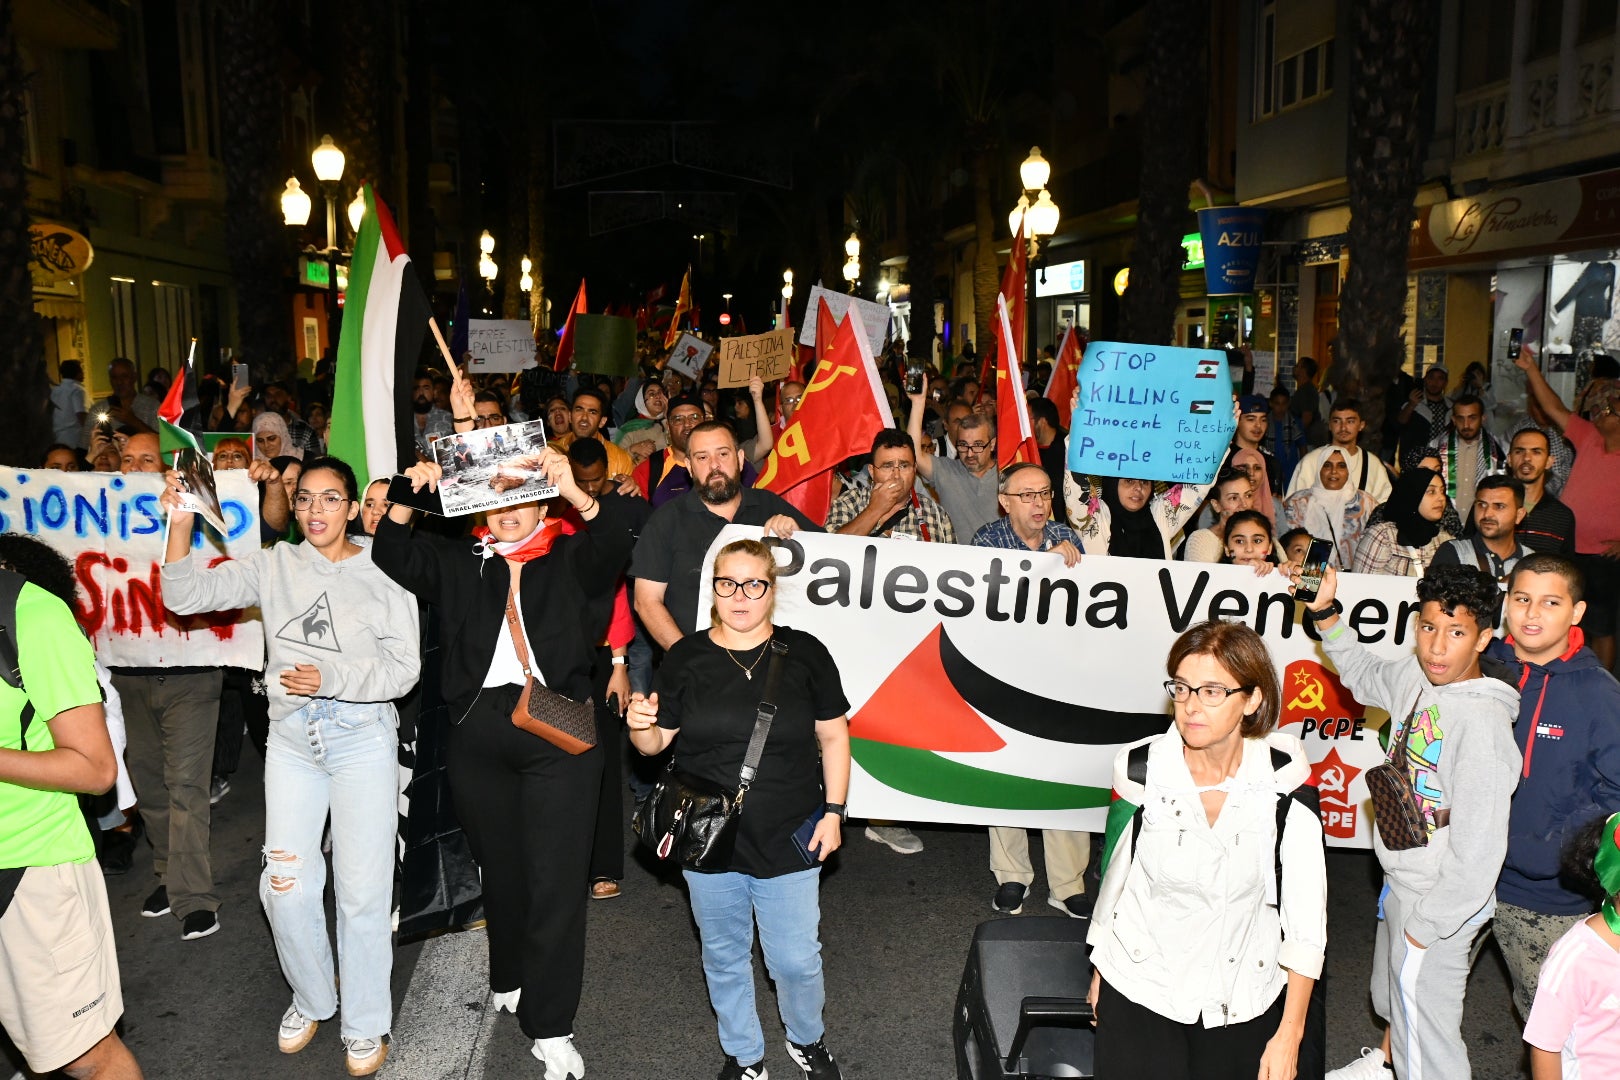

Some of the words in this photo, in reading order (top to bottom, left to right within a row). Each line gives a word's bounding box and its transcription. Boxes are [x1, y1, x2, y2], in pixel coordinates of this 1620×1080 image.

[1444, 203, 1480, 246] La
[1217, 231, 1260, 247] AZUL
[470, 328, 507, 340] #FREE
[724, 336, 784, 360] PALESTINA
[729, 354, 784, 382] LIBRE
[1094, 350, 1156, 372] STOP
[1090, 382, 1180, 405] KILLING
[1083, 409, 1162, 429] Innocent
[1079, 436, 1151, 471] People
[1174, 440, 1201, 450] OUR
[1175, 452, 1217, 464] Heart
[1171, 468, 1199, 480] with
[1204, 472, 1216, 482] yo
[448, 506, 472, 514] ISRAEL
[520, 488, 555, 500] MASCOTAS
[760, 535, 1130, 630] Palestina
[1158, 567, 1507, 646] Vencer
[1300, 718, 1366, 741] PCPE
